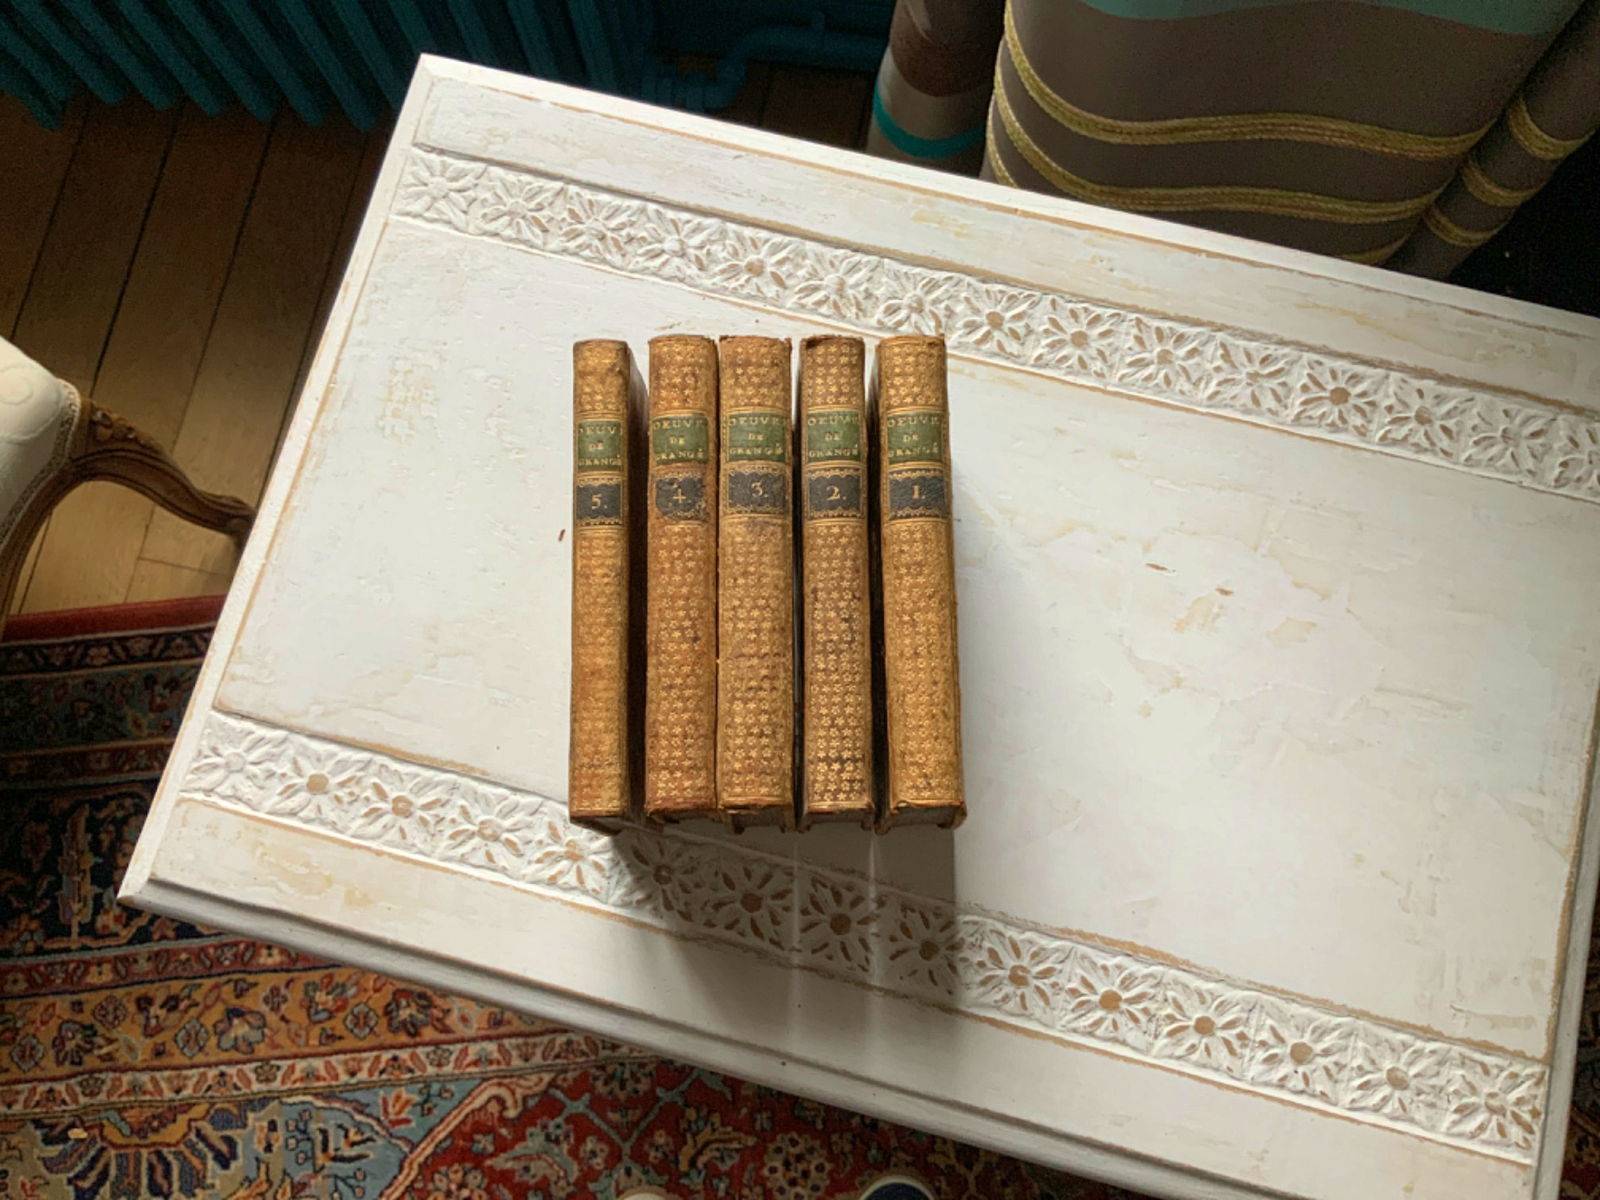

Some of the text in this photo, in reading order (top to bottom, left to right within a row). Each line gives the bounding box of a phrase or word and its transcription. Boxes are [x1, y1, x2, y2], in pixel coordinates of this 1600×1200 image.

[669, 436, 686, 445] DE
[748, 432, 765, 441] DE
[824, 432, 841, 442] DE
[903, 432, 920, 443] DE
[751, 480, 769, 498] 3.
[826, 485, 847, 501] 2.
[591, 493, 608, 509] 5.
